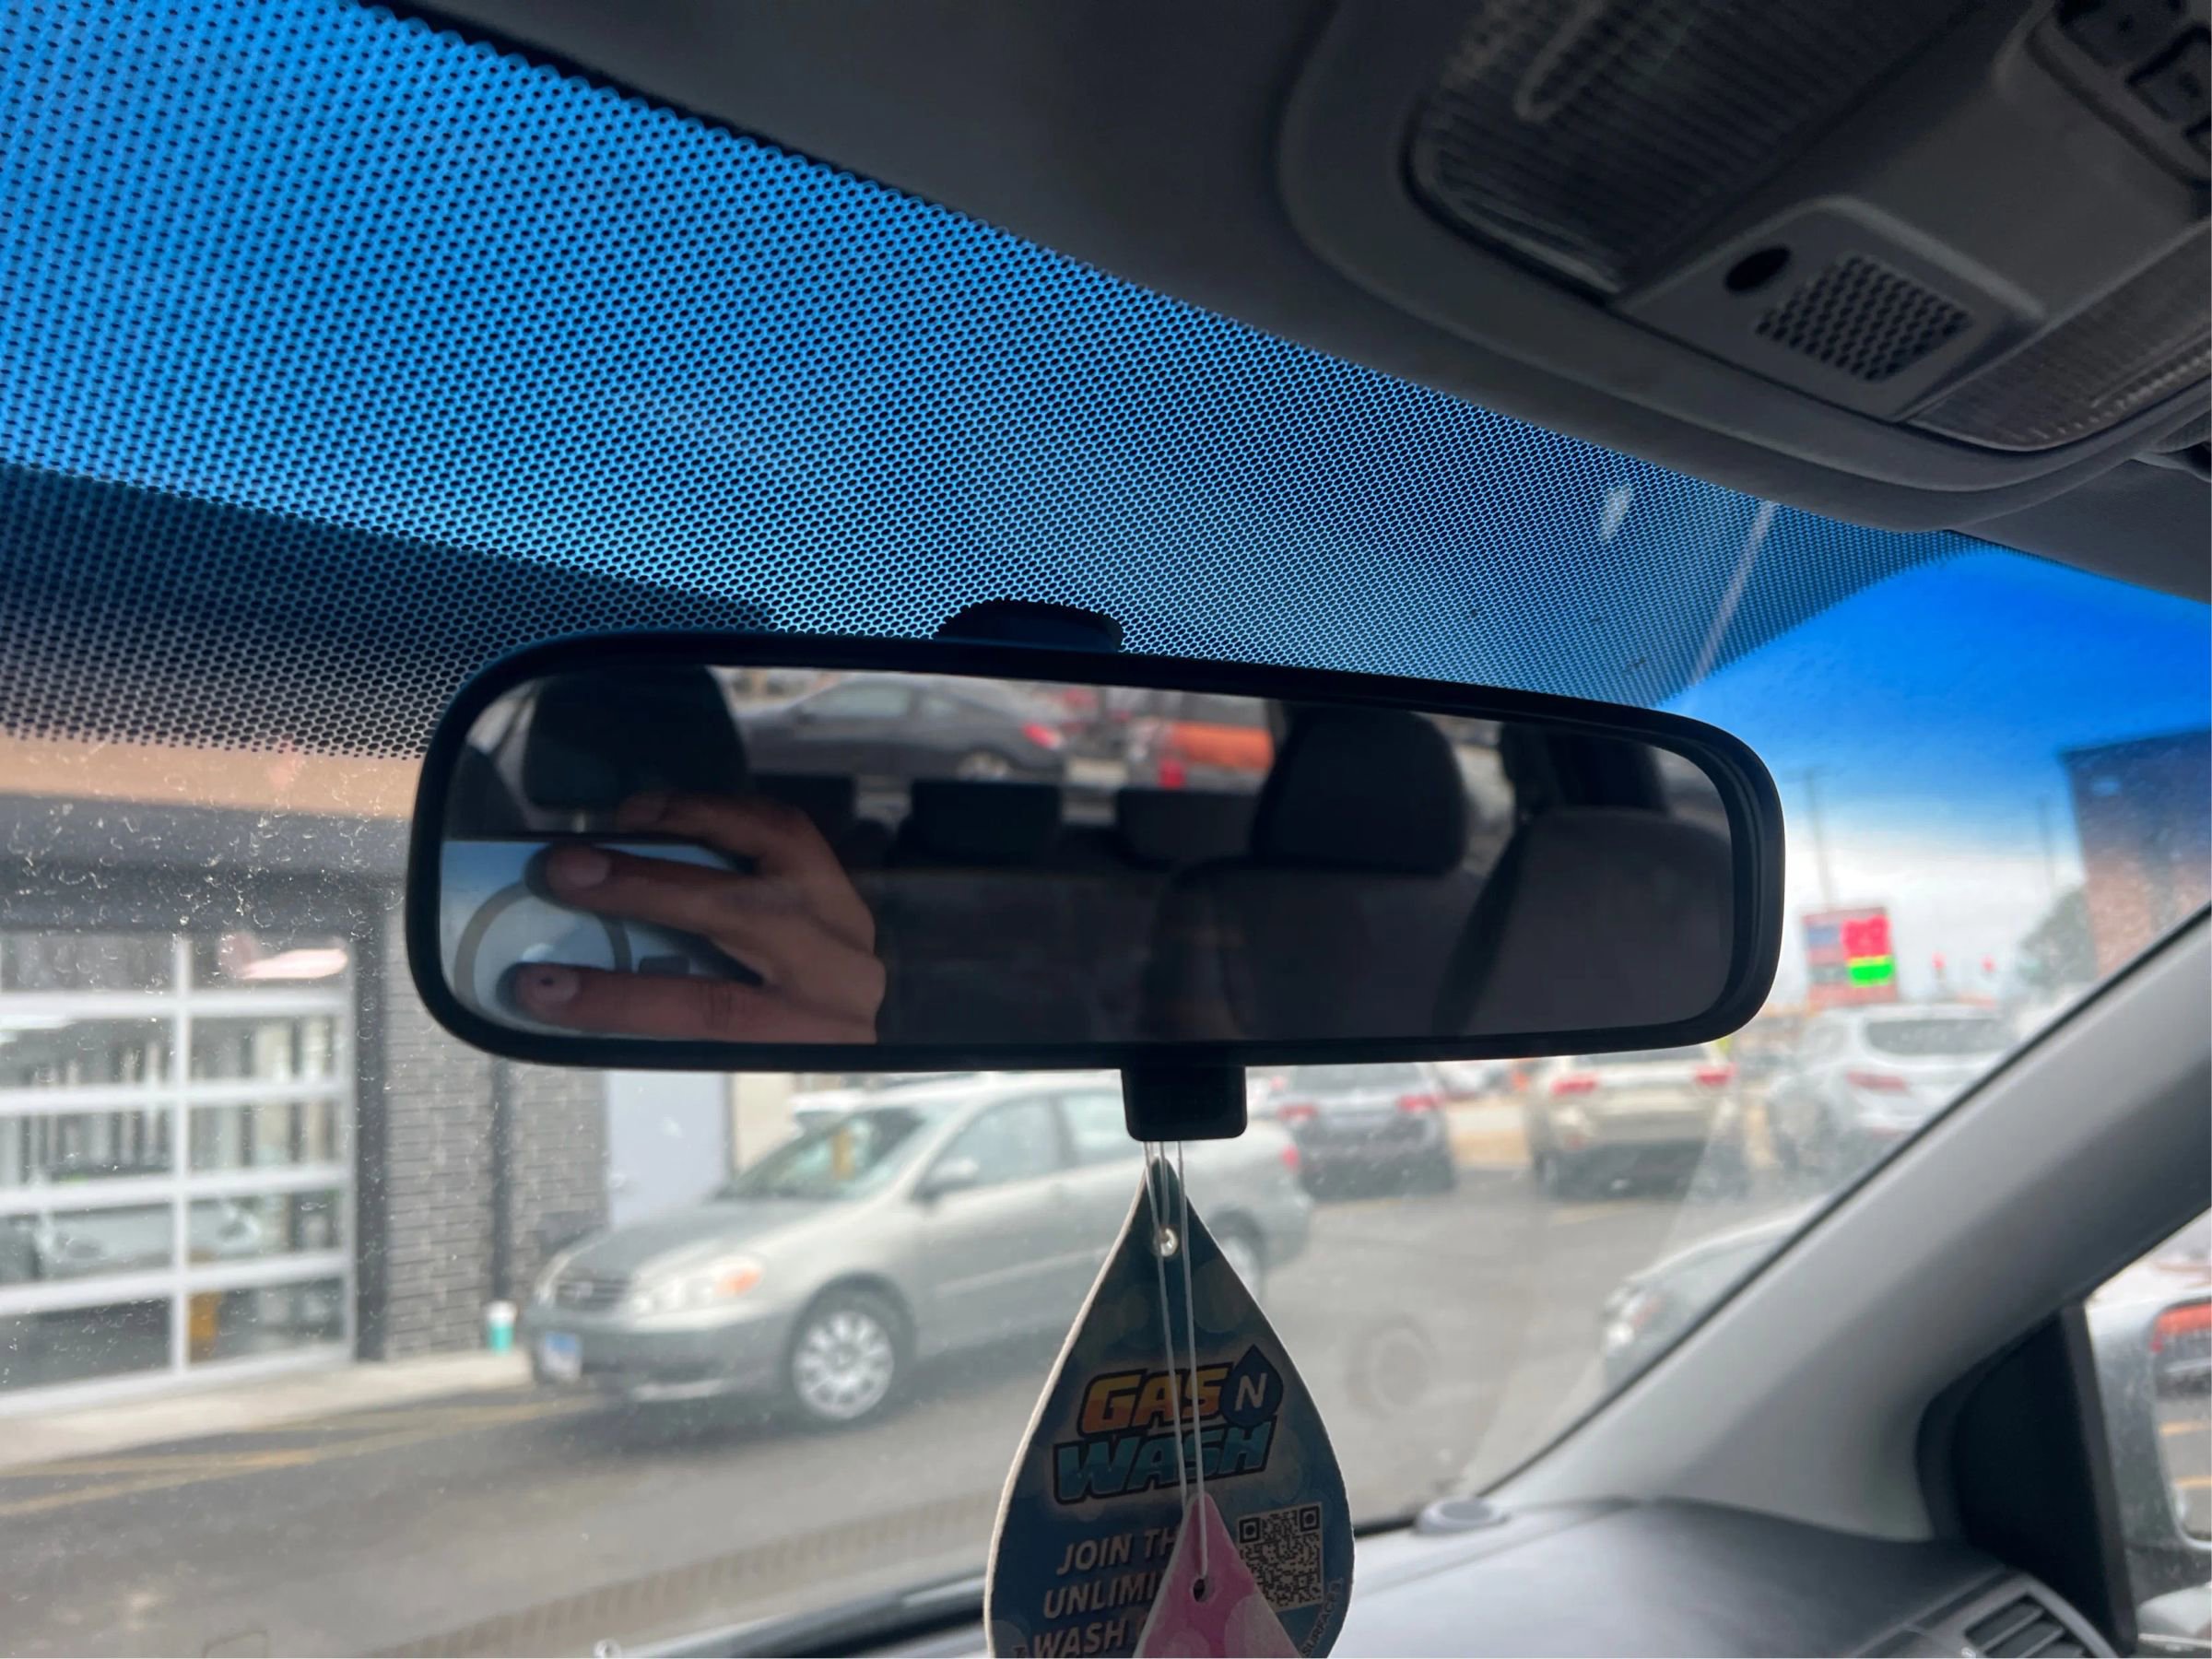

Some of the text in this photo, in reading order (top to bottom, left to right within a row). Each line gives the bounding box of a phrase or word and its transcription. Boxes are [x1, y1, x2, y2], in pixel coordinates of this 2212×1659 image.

[1079, 1363, 1267, 1436] GAS N
[1055, 1418, 1275, 1503] WASH
[1056, 1525, 1182, 1576] JOIN TH
[1042, 1569, 1159, 1619] UNLIMI
[1031, 1617, 1127, 1659] WASH
